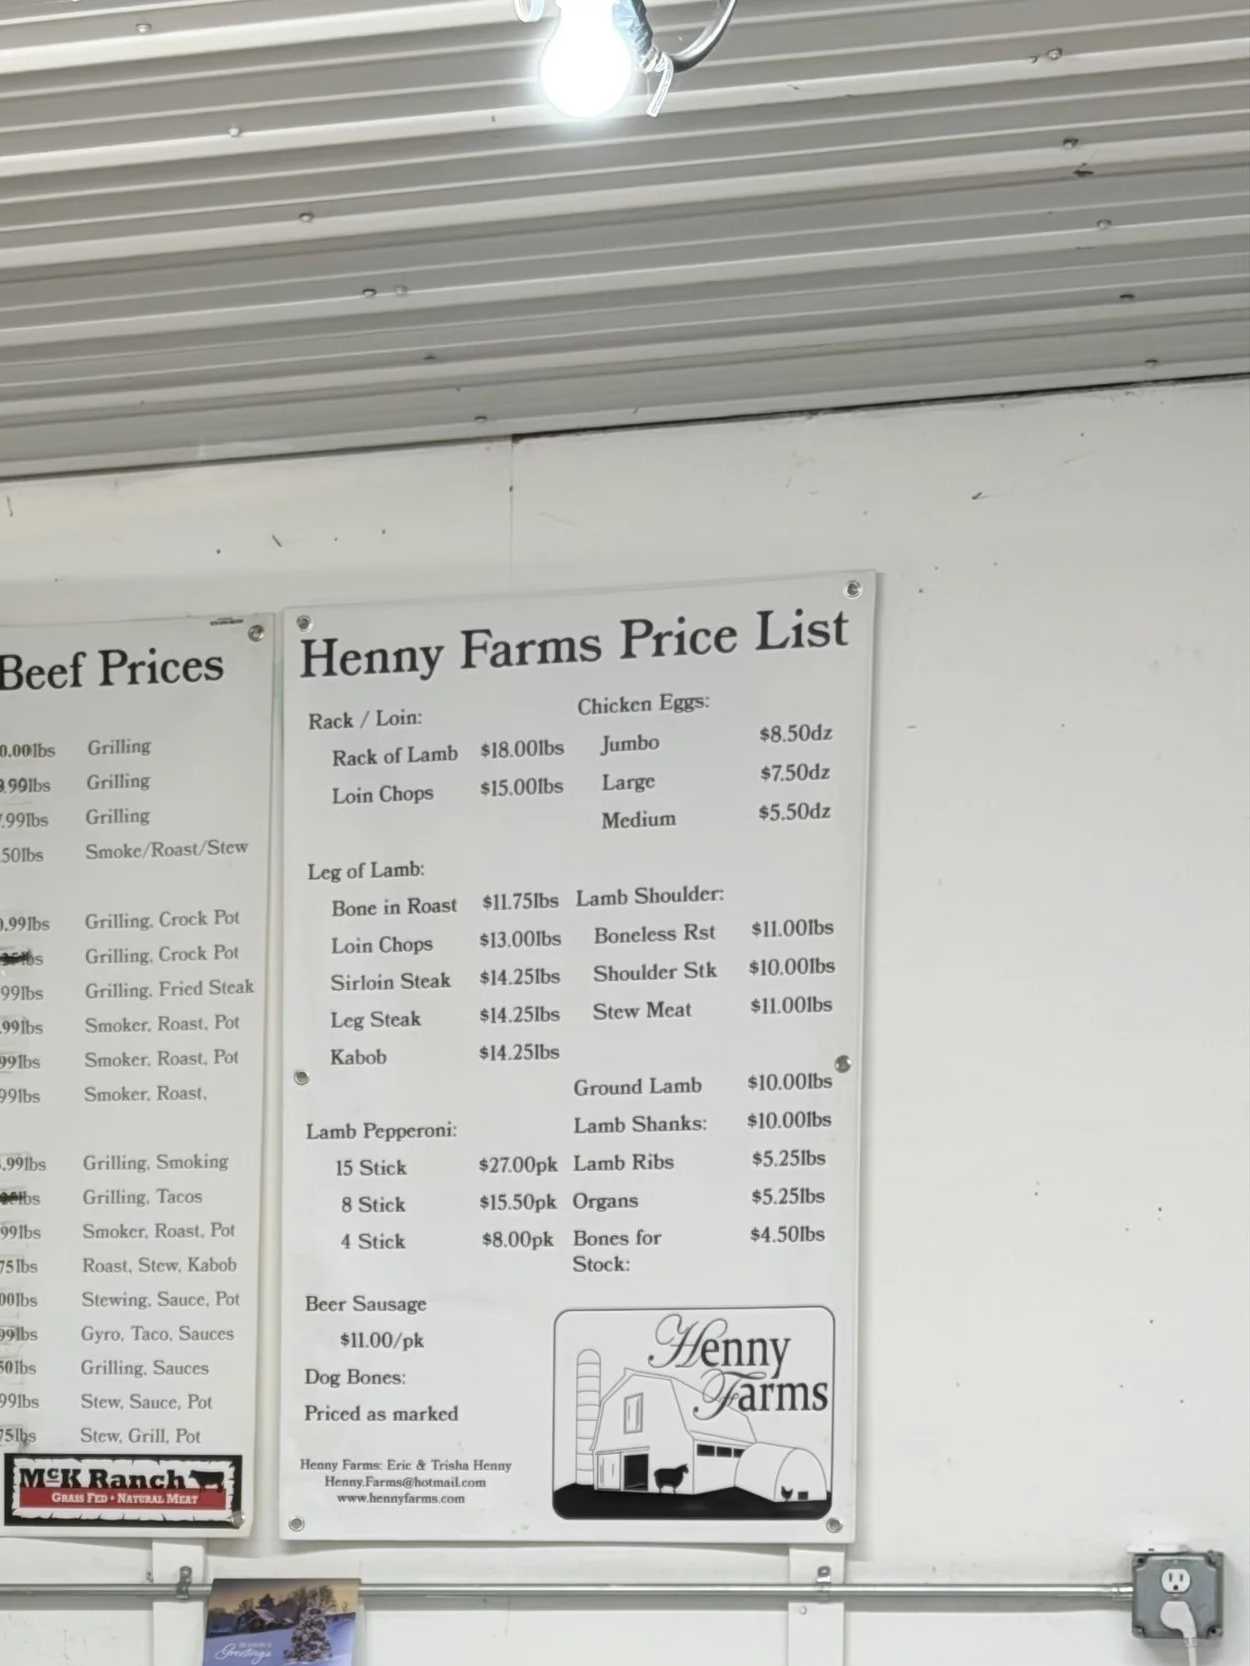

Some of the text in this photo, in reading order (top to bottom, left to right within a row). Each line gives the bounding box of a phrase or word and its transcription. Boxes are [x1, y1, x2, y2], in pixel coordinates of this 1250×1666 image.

[300, 608, 849, 681] Henny Farms Price List
[98, 647, 224, 686] Prices
[578, 693, 709, 715] Chicken Eggs:
[309, 709, 422, 730] Rack Loin:
[88, 738, 151, 756] Grilling
[600, 724, 832, 756] Jumbo $8.50dz
[332, 739, 565, 767] Rack of Lamb $18.00lbs
[602, 763, 830, 793] Large $7.50dz
[332, 777, 564, 804] Loin Chops $15.00lbs
[602, 802, 831, 829] Medium $5.50dz
[308, 860, 424, 883] Leg of Lamb:
[332, 892, 559, 917] Bone in Roast $11.75lbs
[576, 885, 724, 907] Lamb Shoulder:
[594, 918, 834, 944] Boneless Rst $11.00lbs
[331, 968, 561, 991] Sirloin Steak $14.25lbs
[594, 957, 835, 982] Shoulder Stk $10.00lbs
[593, 996, 833, 1020] Stew Meat $11.00lbs
[330, 1043, 560, 1065] Kabob $14.25lbs
[574, 1072, 833, 1096] Ground Lamb $10.00lbs
[306, 1121, 457, 1142] Lamb Pepperoni:
[574, 1110, 832, 1134] Lamb Shanks: $10.00lbs
[336, 1155, 558, 1176] 15 Stick $27.00pk
[573, 1187, 825, 1212] Organs $5.25lbs
[341, 1230, 554, 1251] 4 Stick $8.00pk
[574, 1225, 825, 1246] Bones for $4.50lbs
[573, 1255, 630, 1272] Stock:
[305, 1295, 427, 1315] Beer Sausage
[340, 1332, 424, 1351] $11.00/pk
[648, 1313, 791, 1379] Henny
[305, 1368, 406, 1388] Dog Bones:
[693, 1368, 828, 1420] Farms
[304, 1405, 458, 1421] Priced as marked
[300, 1458, 338, 1472] Henny
[387, 1459, 411, 1470] Eric
[416, 1459, 426, 1470] &
[431, 1459, 469, 1471] Trisha
[473, 1459, 512, 1473] Henny
[89, 1469, 186, 1489] Ranch
[325, 1475, 486, 1489] Henny.Farms@hotmail.com
[337, 1492, 465, 1505] www.hennyfarms.com
